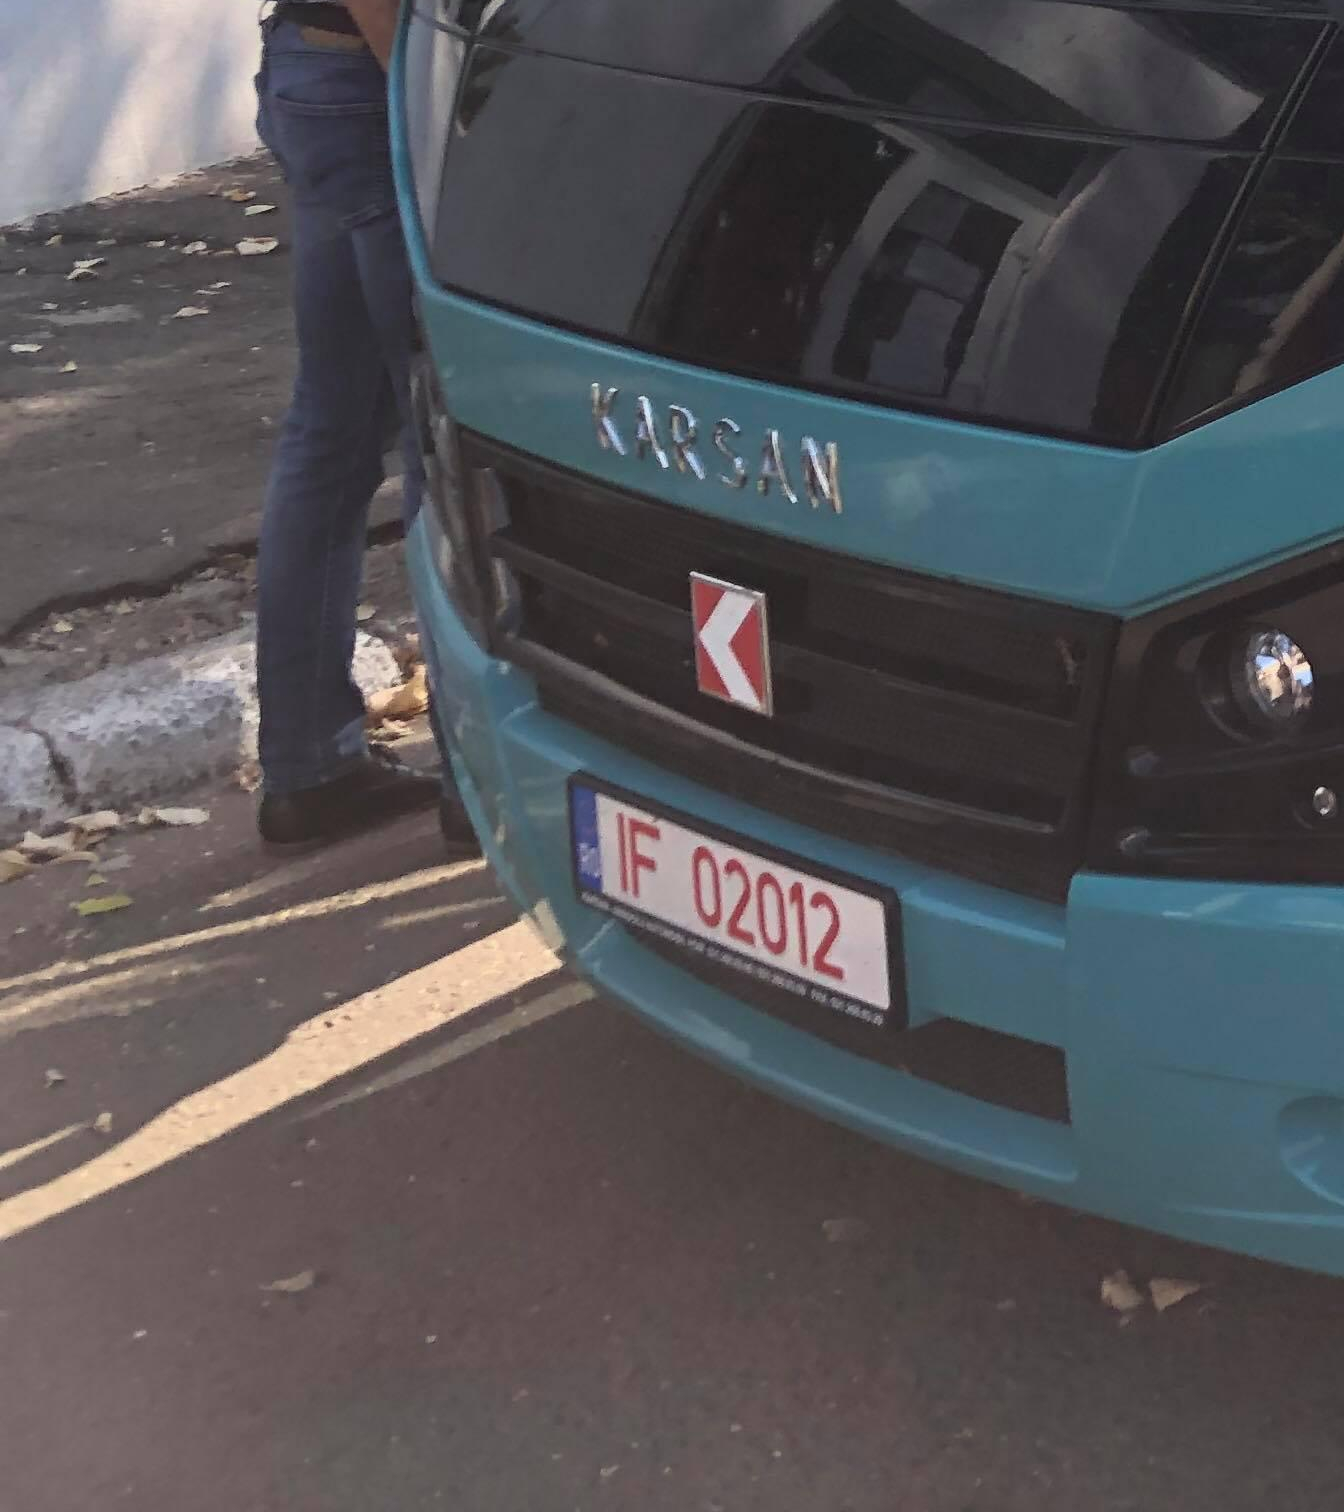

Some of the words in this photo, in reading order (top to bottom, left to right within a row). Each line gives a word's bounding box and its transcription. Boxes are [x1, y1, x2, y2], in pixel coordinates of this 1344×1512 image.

[590, 381, 843, 515] KARSAN
[616, 811, 661, 899] IF
[691, 845, 845, 981] 02012
